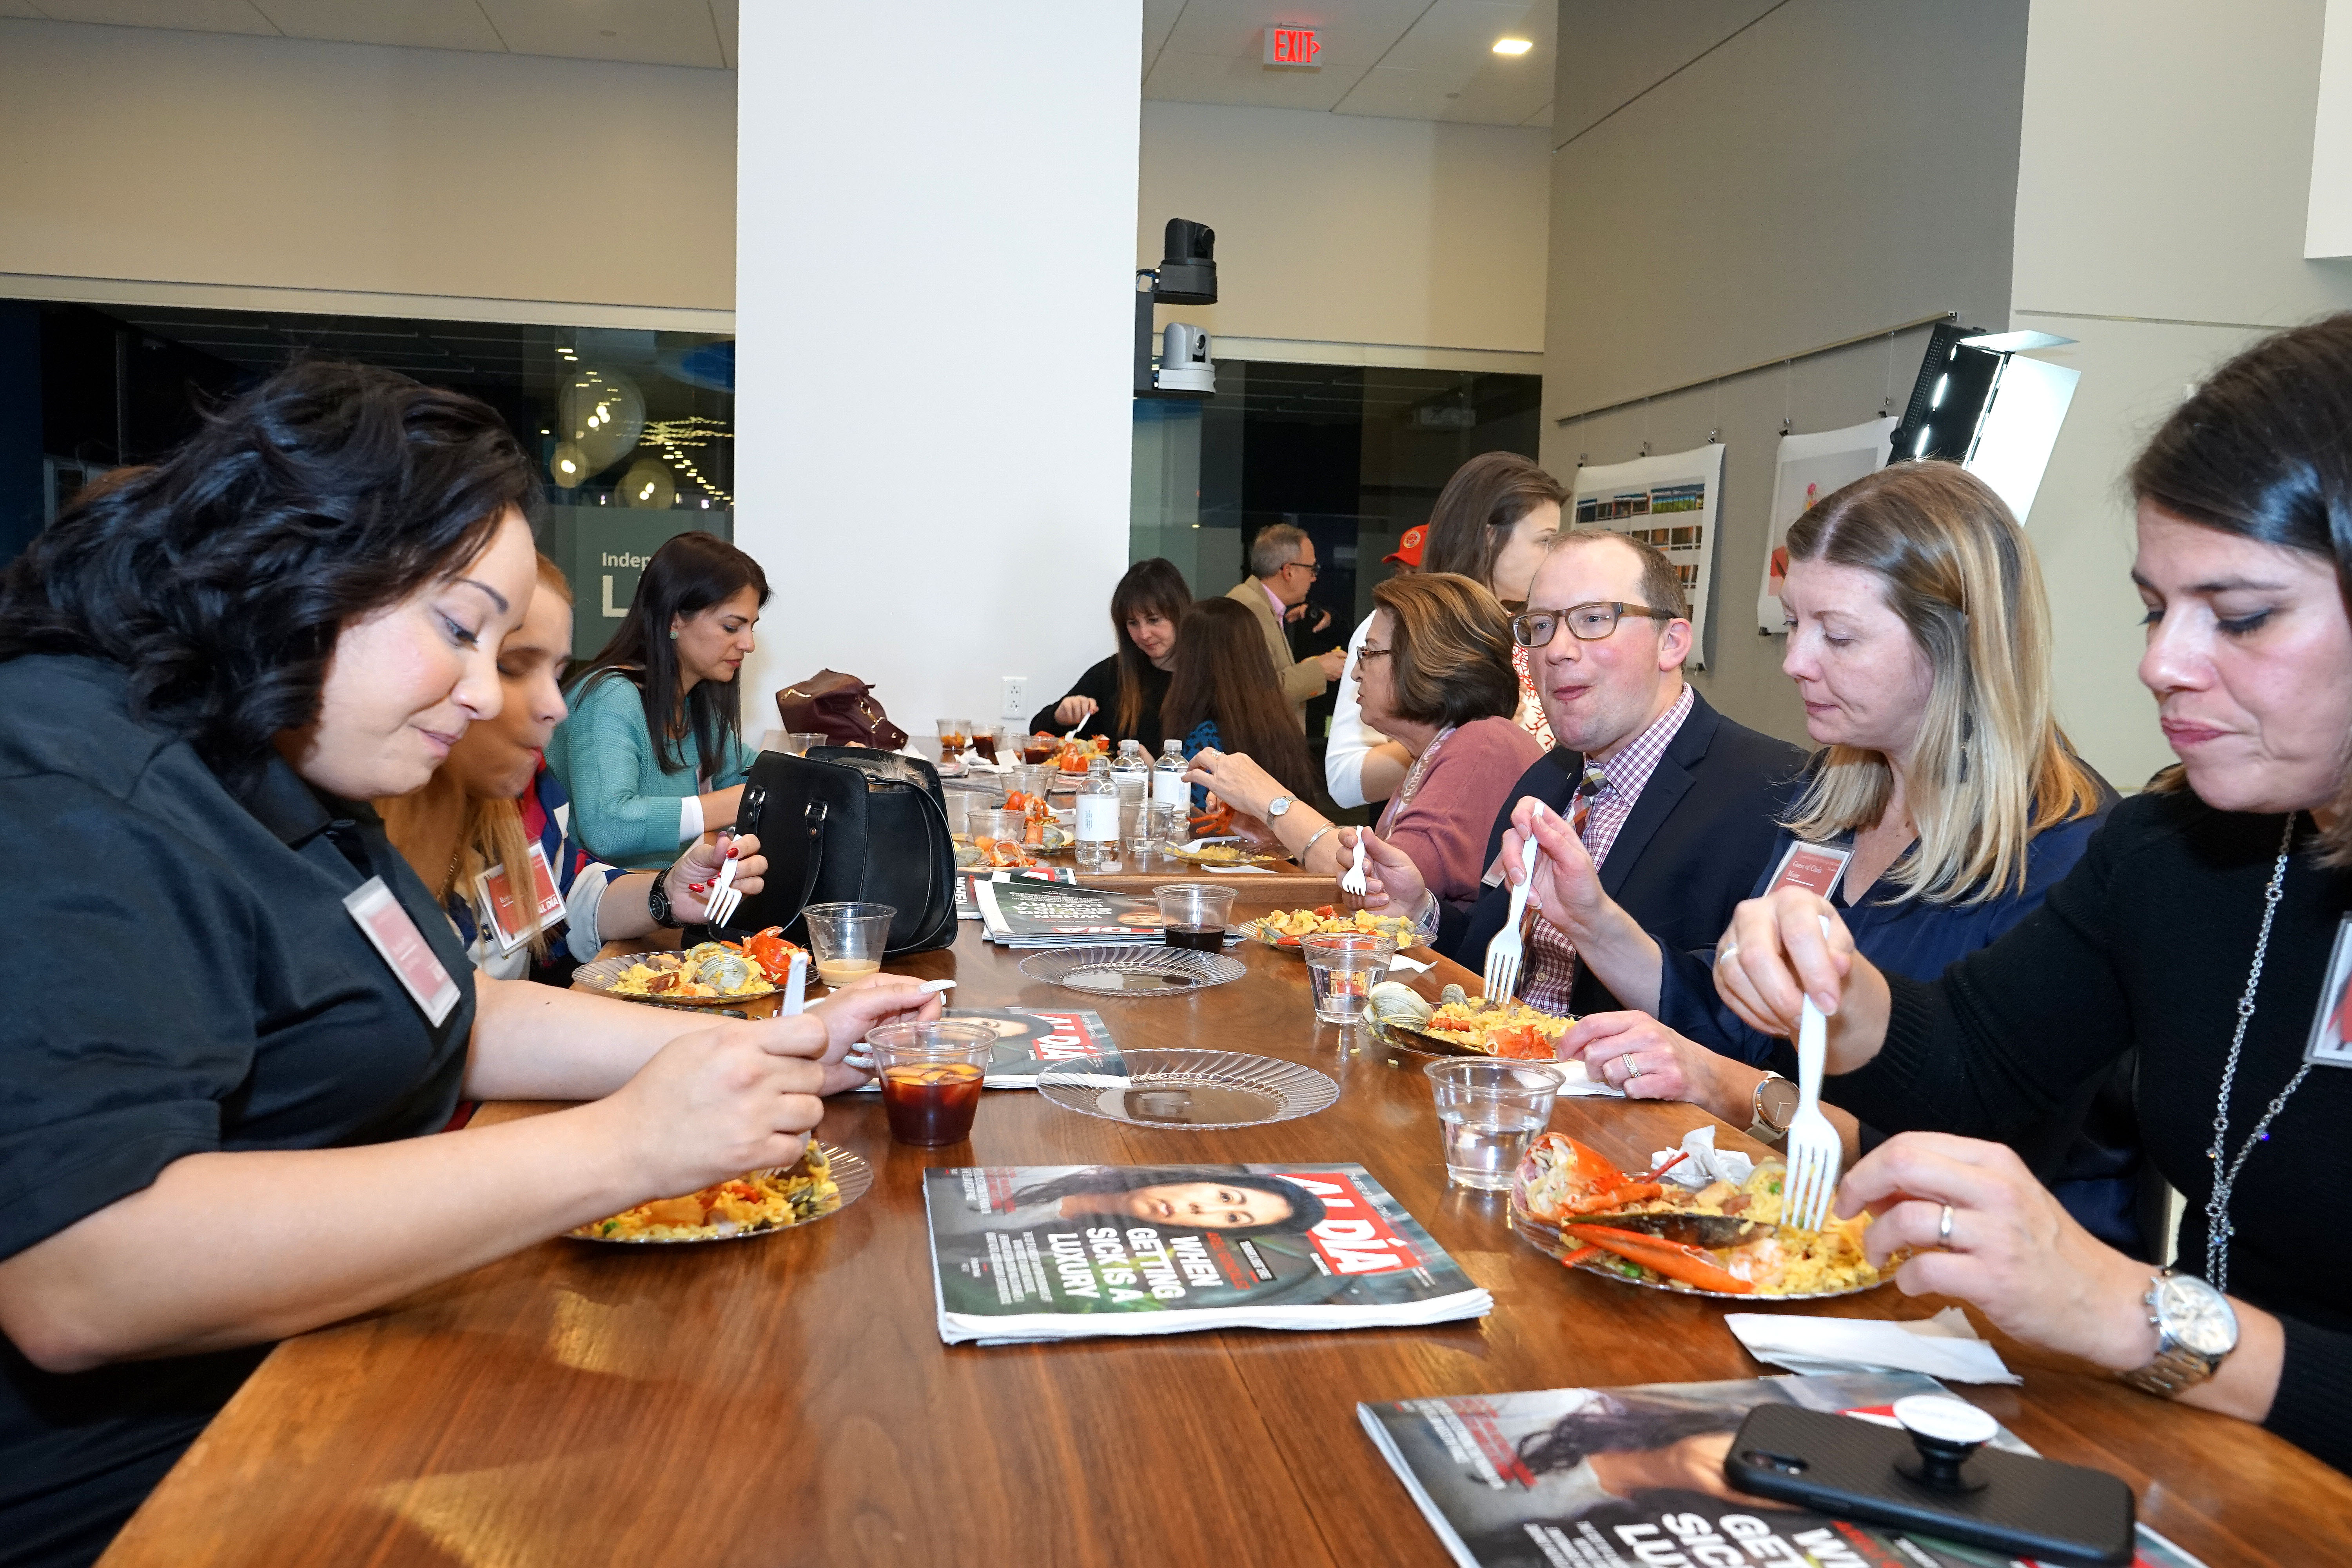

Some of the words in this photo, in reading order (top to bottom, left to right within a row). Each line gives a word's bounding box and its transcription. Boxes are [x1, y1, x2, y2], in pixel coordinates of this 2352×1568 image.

[1274, 29, 1314, 62] EXIT
[955, 877, 968, 905] WHEN
[1086, 1227, 1130, 1266] SICK
[1126, 1227, 1186, 1299] GETTING
[1170, 1236, 1223, 1286] WHEN
[1311, 1219, 1408, 1273] DÍA
[1047, 1233, 1101, 1299] LUXURY
[1100, 1267, 1137, 1285] IS
[1108, 1288, 1145, 1303] A
